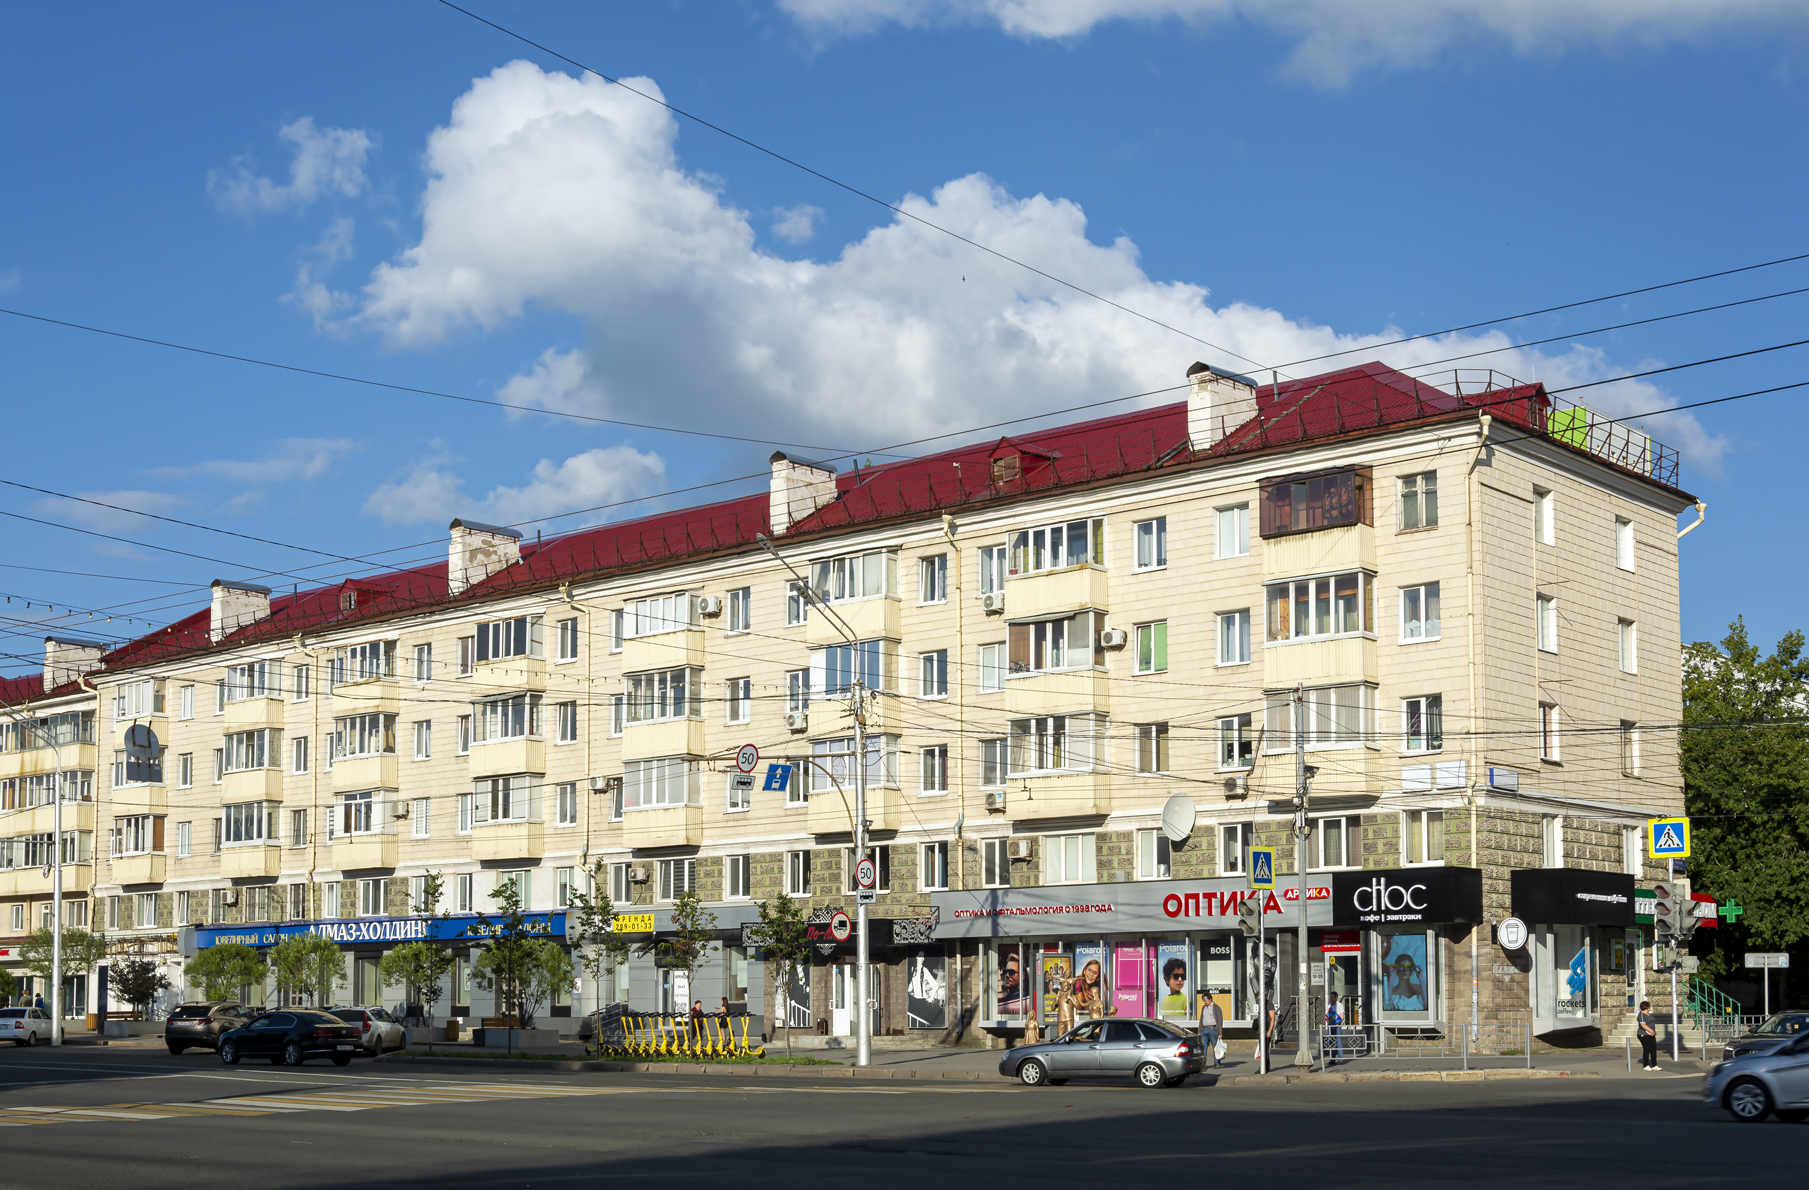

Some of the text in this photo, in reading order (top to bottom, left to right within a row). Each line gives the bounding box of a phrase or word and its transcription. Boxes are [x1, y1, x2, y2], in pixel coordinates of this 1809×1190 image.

[740, 752, 754, 765] 50
[860, 867, 872, 879] 50
[1286, 887, 1328, 899] АРИКА
[954, 909, 986, 918] ОПТИКА
[992, 905, 1064, 917] ОФТАЛЬМОЛОГИЯ
[1071, 904, 1090, 914] 1998
[1090, 903, 1114, 913] ГОДА
[615, 914, 652, 923] АРЕНДА
[1360, 914, 1422, 922] кофе завтраки
[615, 922, 652, 931] 299-01-33
[215, 933, 288, 945] ЮВЕЛИРНЫЙ САЛОН
[1076, 945, 1107, 954] Polarod
[1210, 946, 1231, 954] BOSS
[1557, 1000, 1586, 1008] rockets
